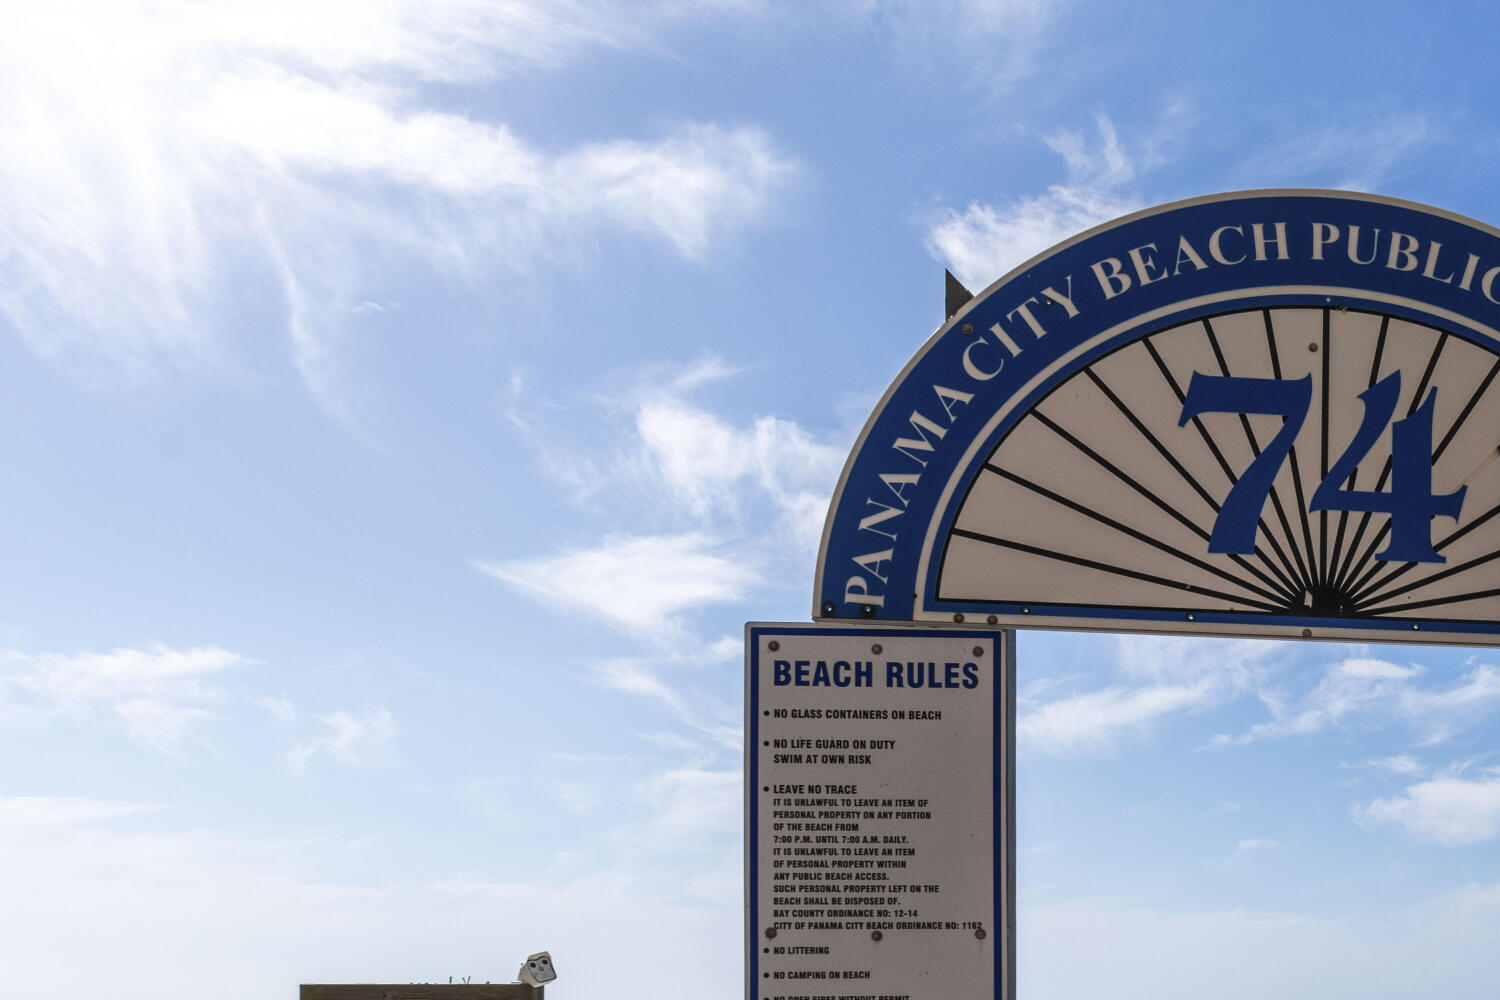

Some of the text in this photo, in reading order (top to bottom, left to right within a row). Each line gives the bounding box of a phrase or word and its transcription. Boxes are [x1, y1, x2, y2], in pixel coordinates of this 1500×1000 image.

[845, 385, 974, 608] PANAMA
[963, 276, 1081, 380] CITY
[1091, 222, 1289, 300] BEACH
[1178, 369, 1468, 564] 74
[773, 661, 978, 688] BEACH RULES
[773, 710, 941, 720] NO GLASS CONTAINERS ON BEACH
[773, 740, 894, 749] NO LIFE GUARD ON DUTY
[773, 755, 871, 764] SWIM AT OWN RISK
[773, 785, 857, 794] LEAVE NO TRACE
[853, 799, 879, 807] LEAVE
[862, 836, 880, 844] A.M.
[882, 836, 908, 844] DAILY.
